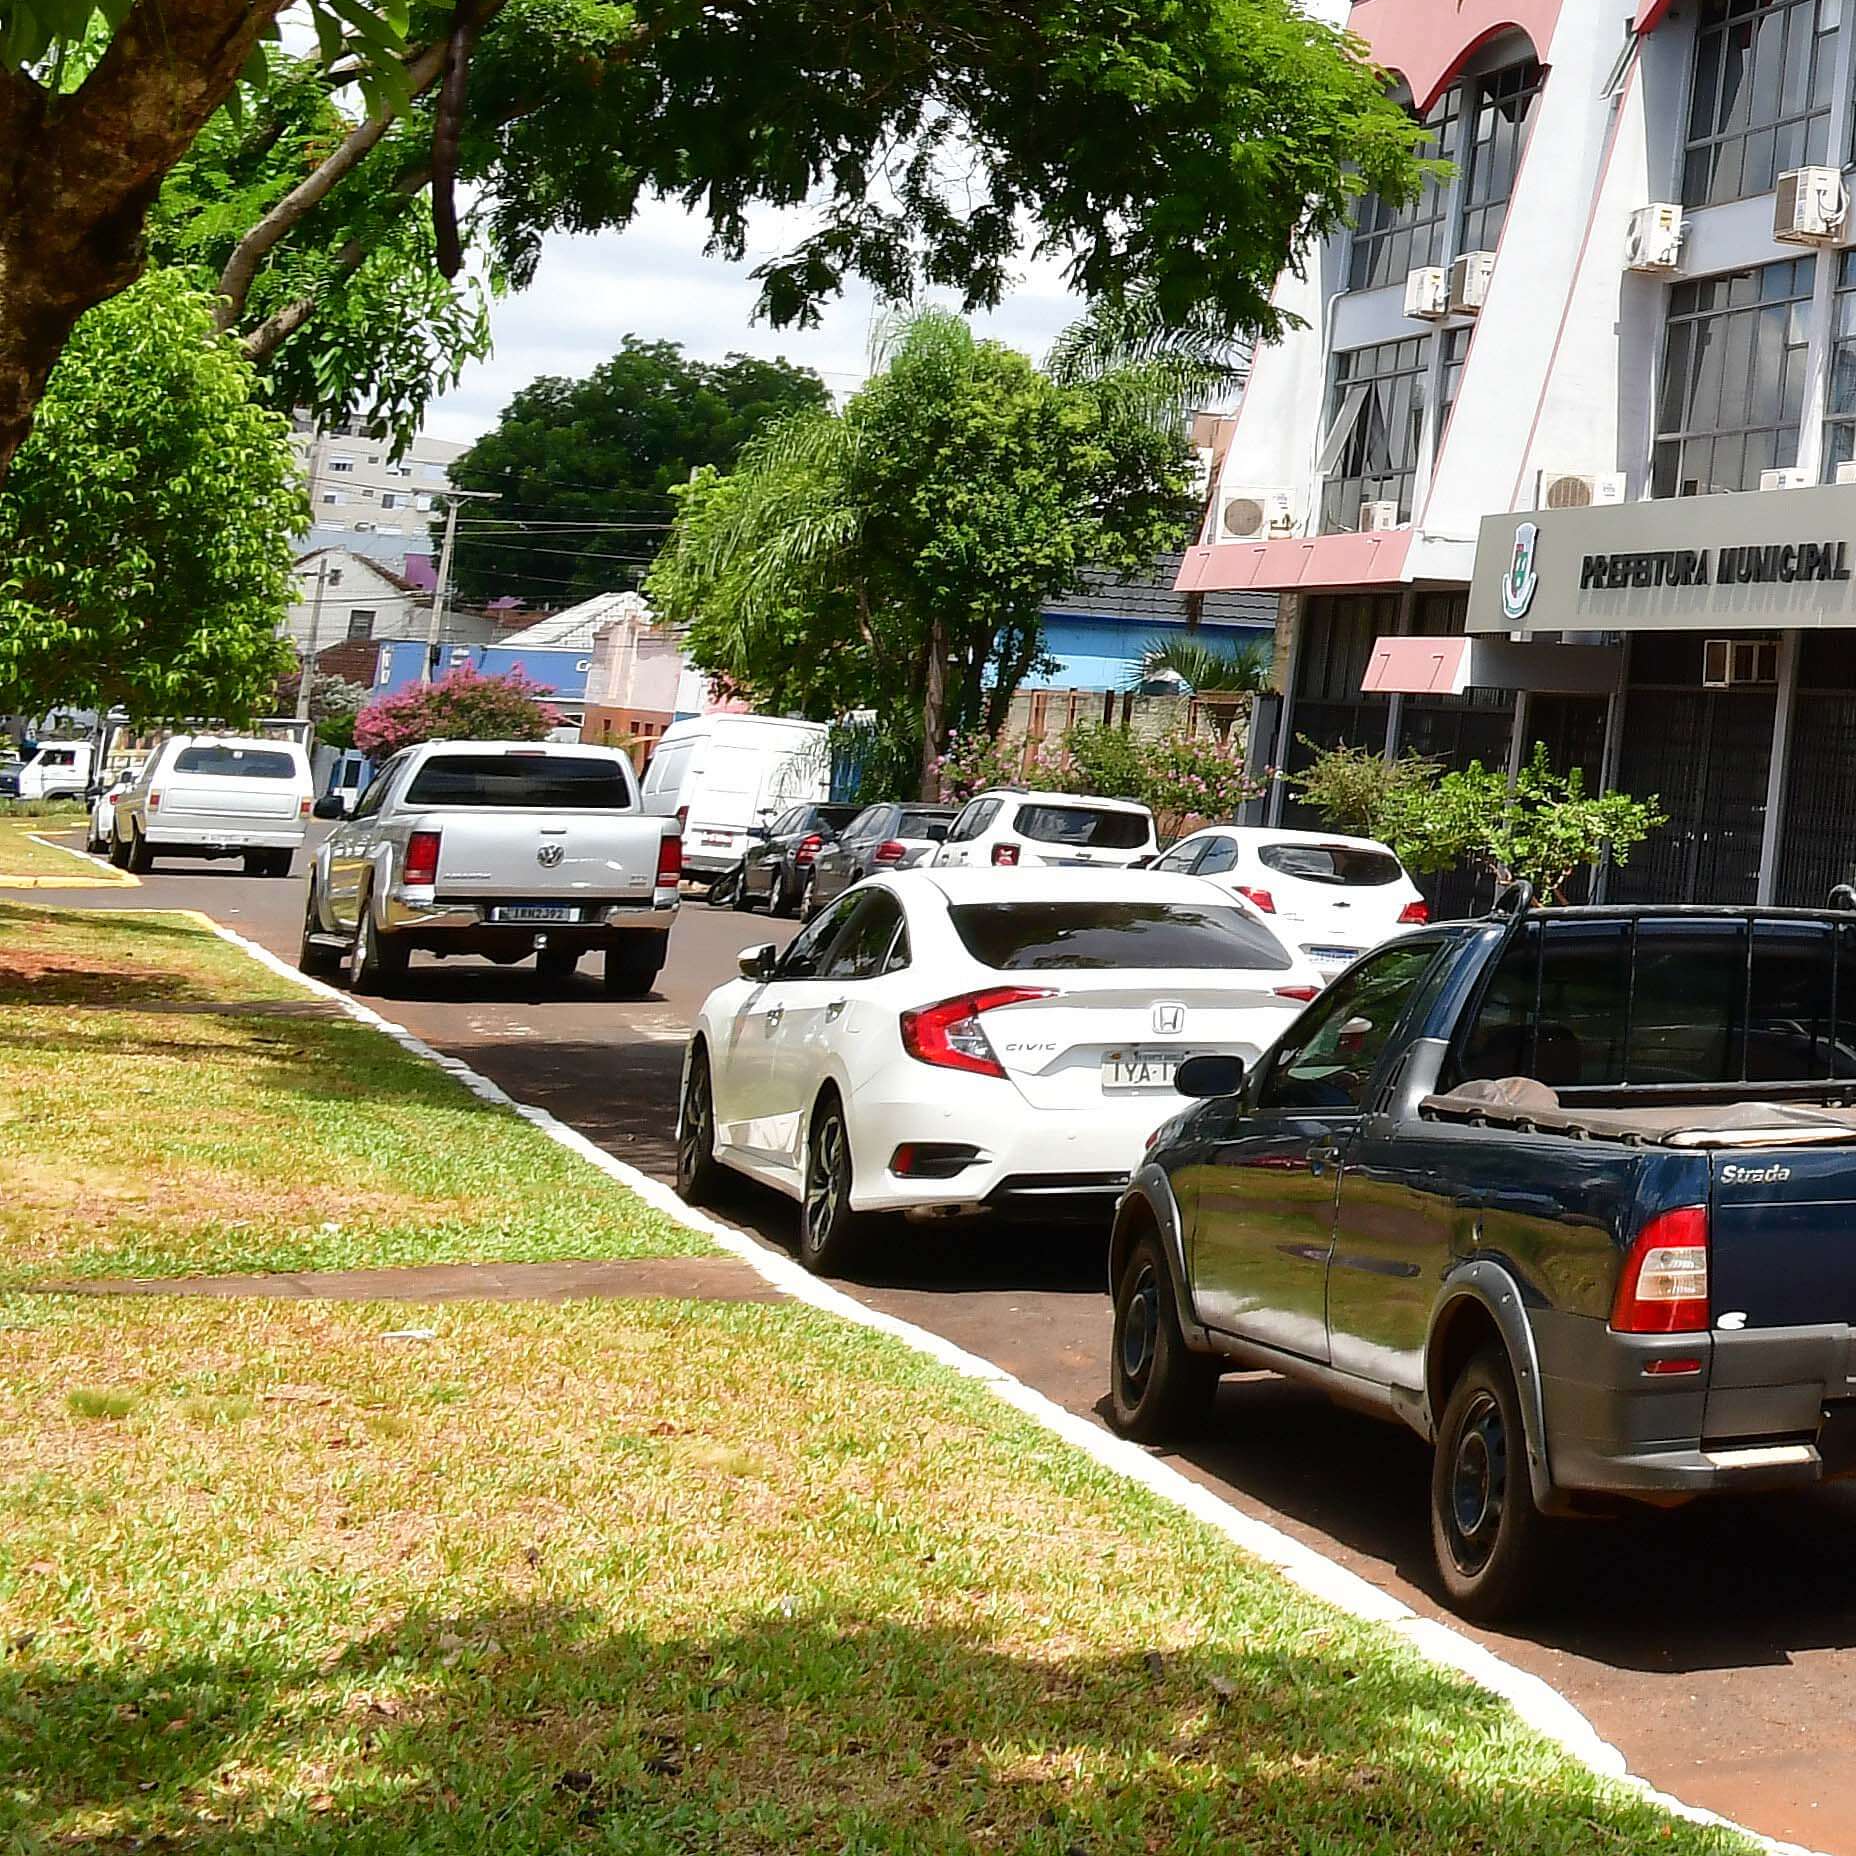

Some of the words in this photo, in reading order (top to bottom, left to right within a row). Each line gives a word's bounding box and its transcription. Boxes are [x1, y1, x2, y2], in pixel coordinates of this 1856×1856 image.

[1579, 548, 1711, 590] PREFEITURA
[1715, 540, 1851, 585] MUNICIPAL
[1005, 1042, 1057, 1051] CIVIC
[1719, 1163, 1791, 1185] Strada
